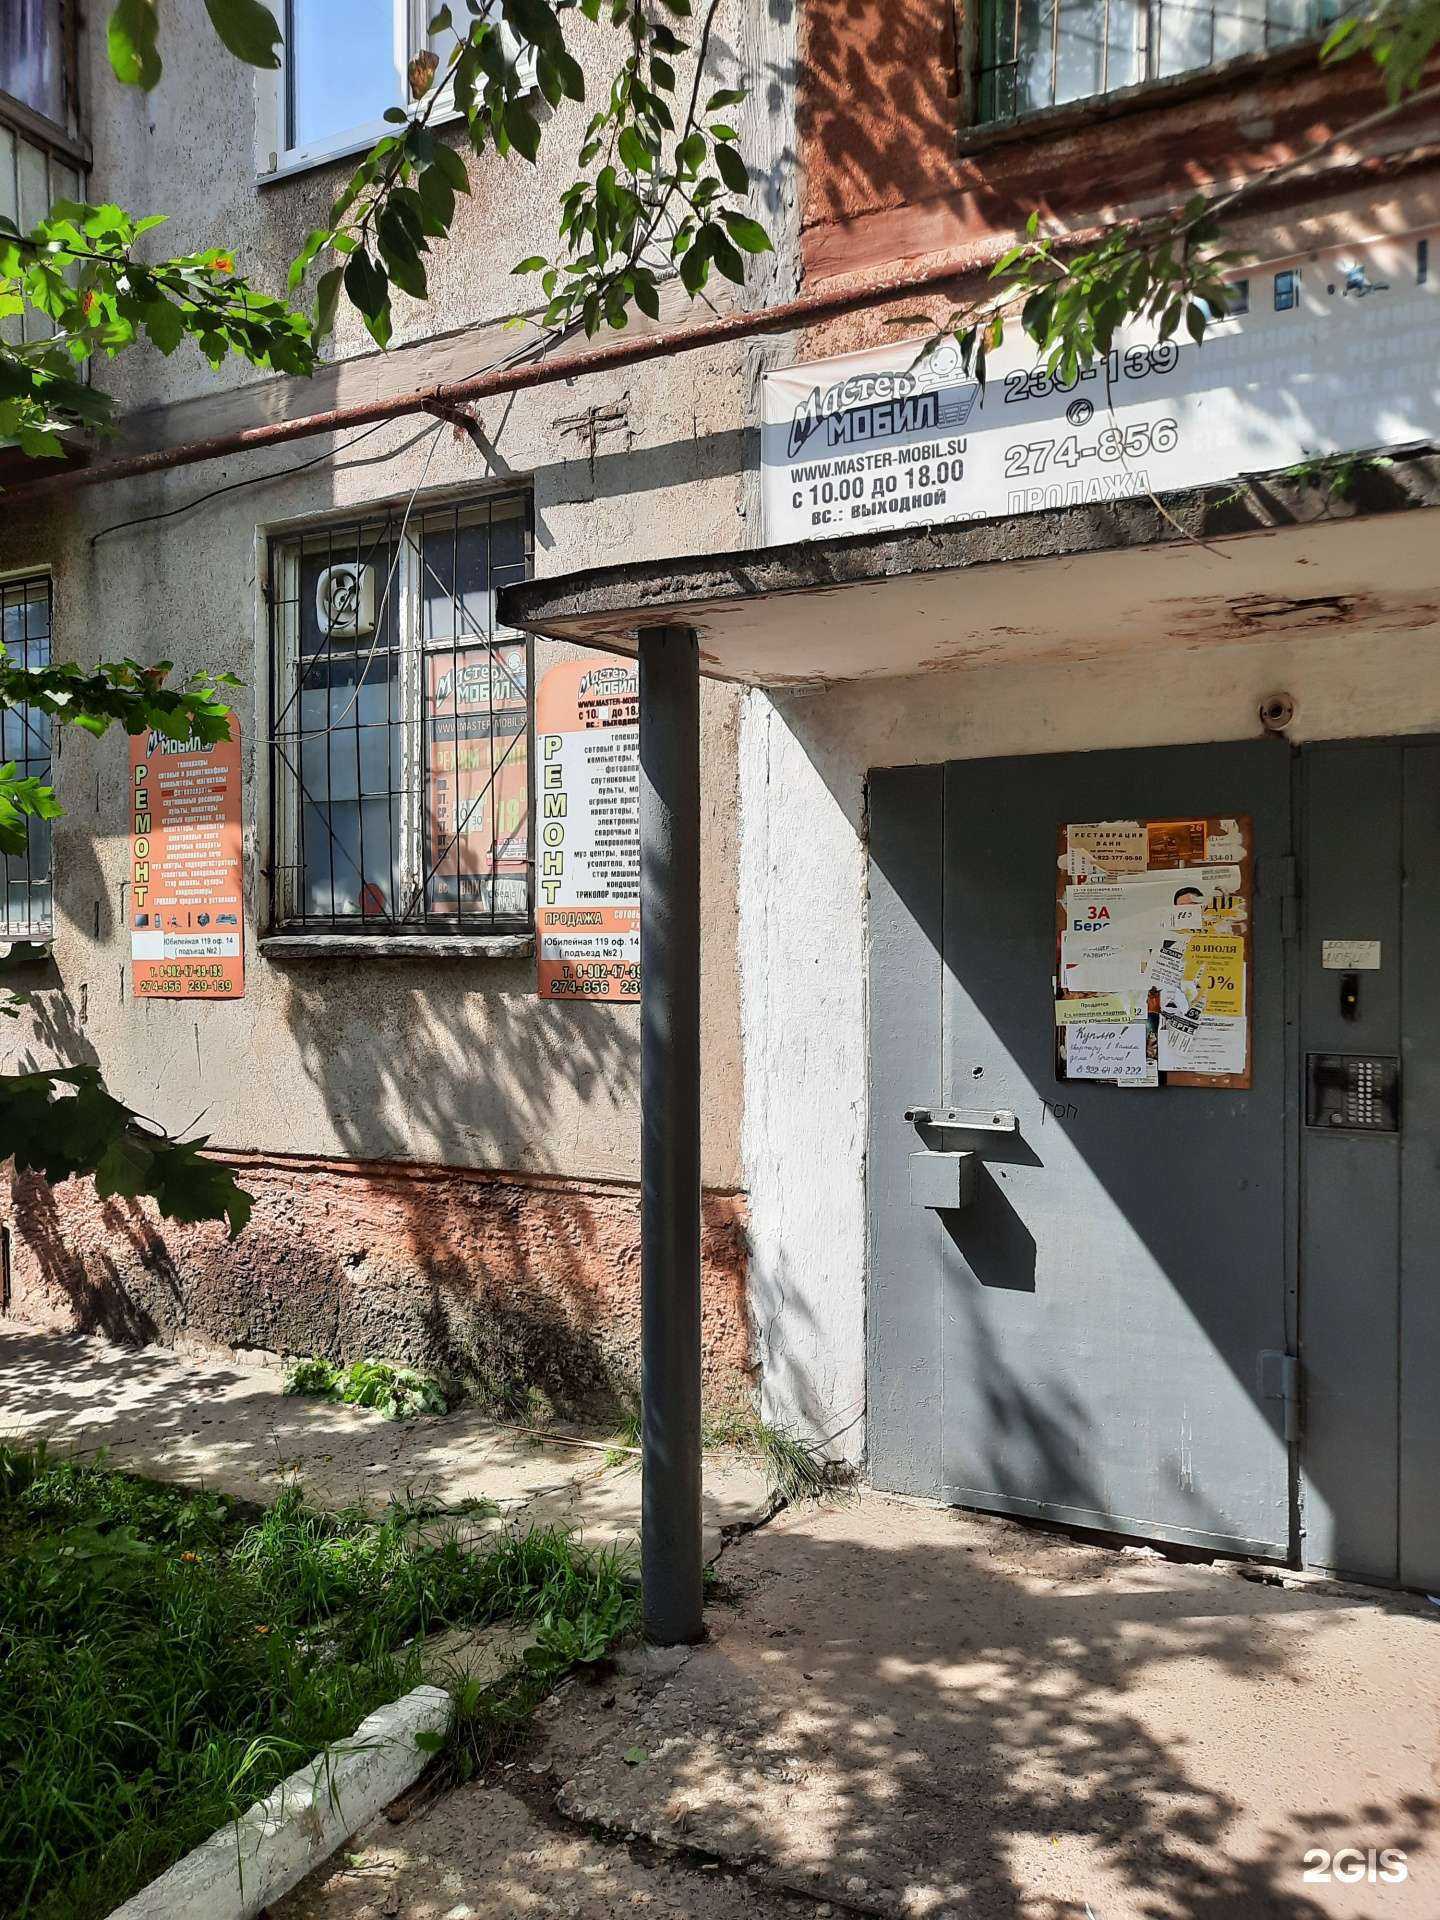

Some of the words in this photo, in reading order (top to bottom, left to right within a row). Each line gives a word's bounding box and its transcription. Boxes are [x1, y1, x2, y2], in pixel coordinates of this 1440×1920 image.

[1004, 339, 1179, 403] 239-139
[788, 372, 916, 458] Мастер
[826, 390, 939, 447] МОБИЛ
[1004, 418, 1178, 478] 274-856
[790, 438, 968, 484] WWW.MASTER-MOBIL.SU
[809, 476, 864, 506] 10.00
[904, 459, 964, 489] 18.00
[1007, 470, 1151, 516] ПРОДАЖА
[456, 681, 511, 704] МОБИЛ
[578, 667, 628, 699] Мастер
[593, 678, 637, 696] МОБИЛ
[625, 705, 639, 716] 18.
[590, 775, 636, 784] спутниковые
[542, 735, 567, 904] РЕМОНТ
[134, 764, 152, 907] РЕМОНТ
[594, 828, 631, 836] сварочные
[576, 890, 609, 899] ТРИКОЛОР
[544, 911, 603, 927] ПРОДАЖА
[1087, 906, 1110, 919] ЗА
[543, 937, 592, 946] Юбилейная
[596, 937, 609, 945] 119
[611, 939, 627, 947] оф.
[630, 937, 639, 945] 14
[602, 949, 617, 957] №2
[140, 980, 181, 992] 274-856
[188, 980, 232, 992] 239-139
[551, 979, 610, 993] 274-856
